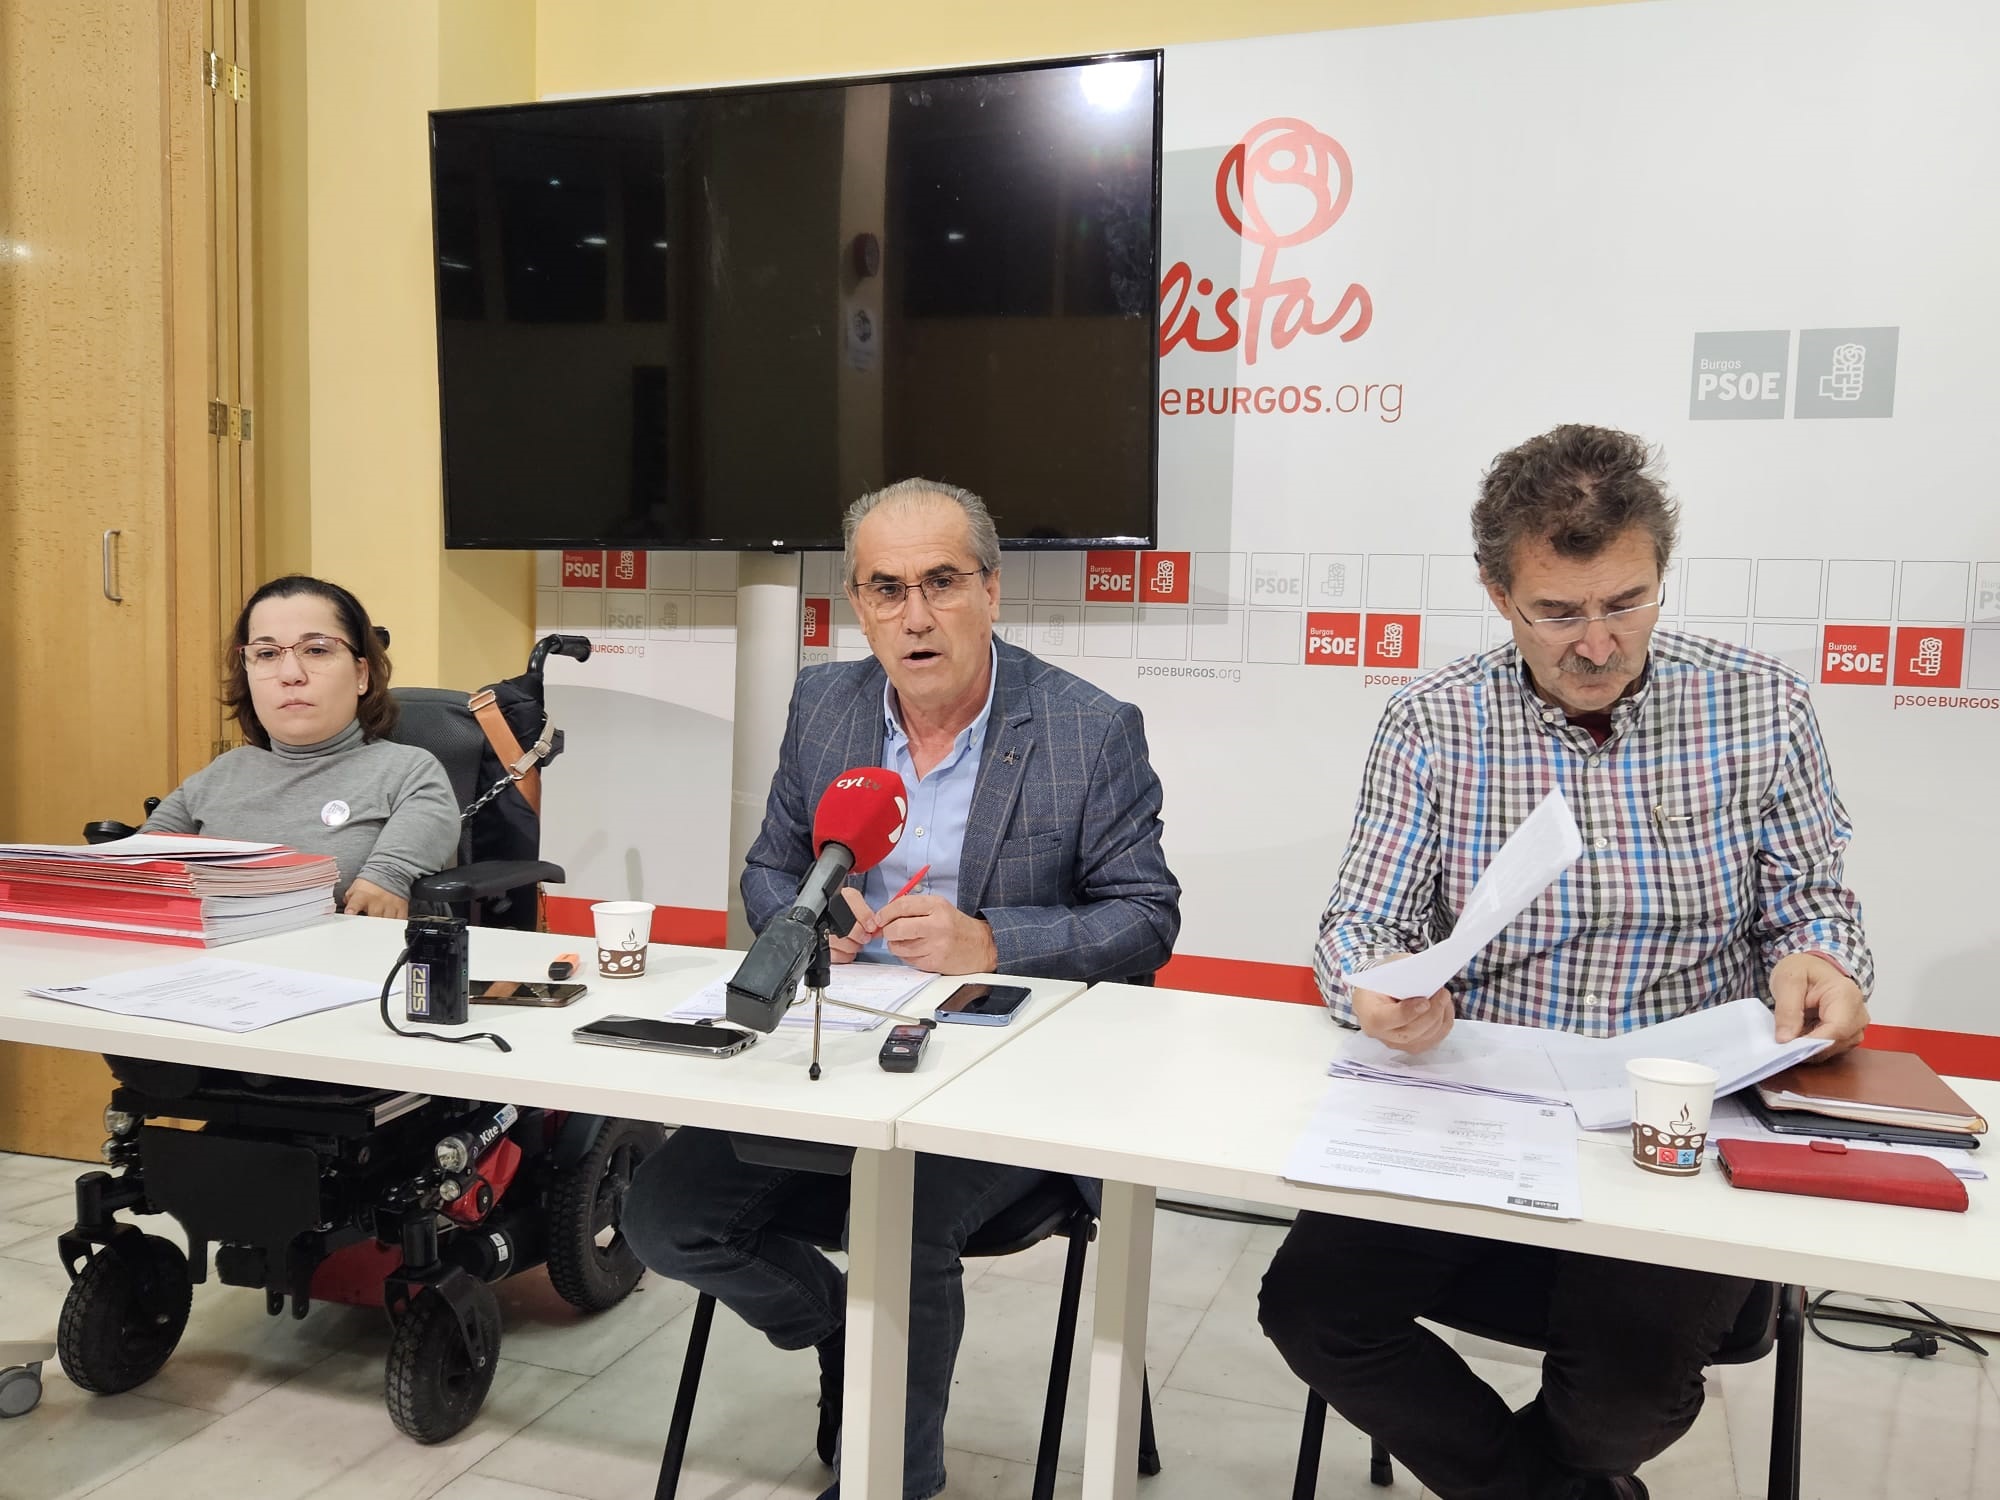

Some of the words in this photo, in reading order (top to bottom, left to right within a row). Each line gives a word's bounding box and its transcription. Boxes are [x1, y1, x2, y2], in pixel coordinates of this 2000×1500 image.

[1160, 261, 1373, 365] listas
[1700, 358, 1743, 372] Burgos
[1698, 372, 1781, 401] PSOE
[1160, 383, 1403, 423] eBURGOS.org
[565, 563, 600, 578] PSOE
[1090, 565, 1112, 574] Burgos
[1089, 574, 1132, 591] PSOE
[1254, 577, 1300, 595] PSOE
[607, 614, 643, 629] PSOE
[1310, 628, 1334, 637] Burgos
[590, 644, 645, 658] BURGOS.org
[1309, 637, 1356, 655] PSOE
[1828, 642, 1857, 652] Burgos
[1826, 653, 1884, 673] PSOE
[1137, 664, 1241, 682] psoeBURGOS.org
[1894, 694, 2000, 710] psoeBURGOS
[480, 1125, 499, 1145] Kite
